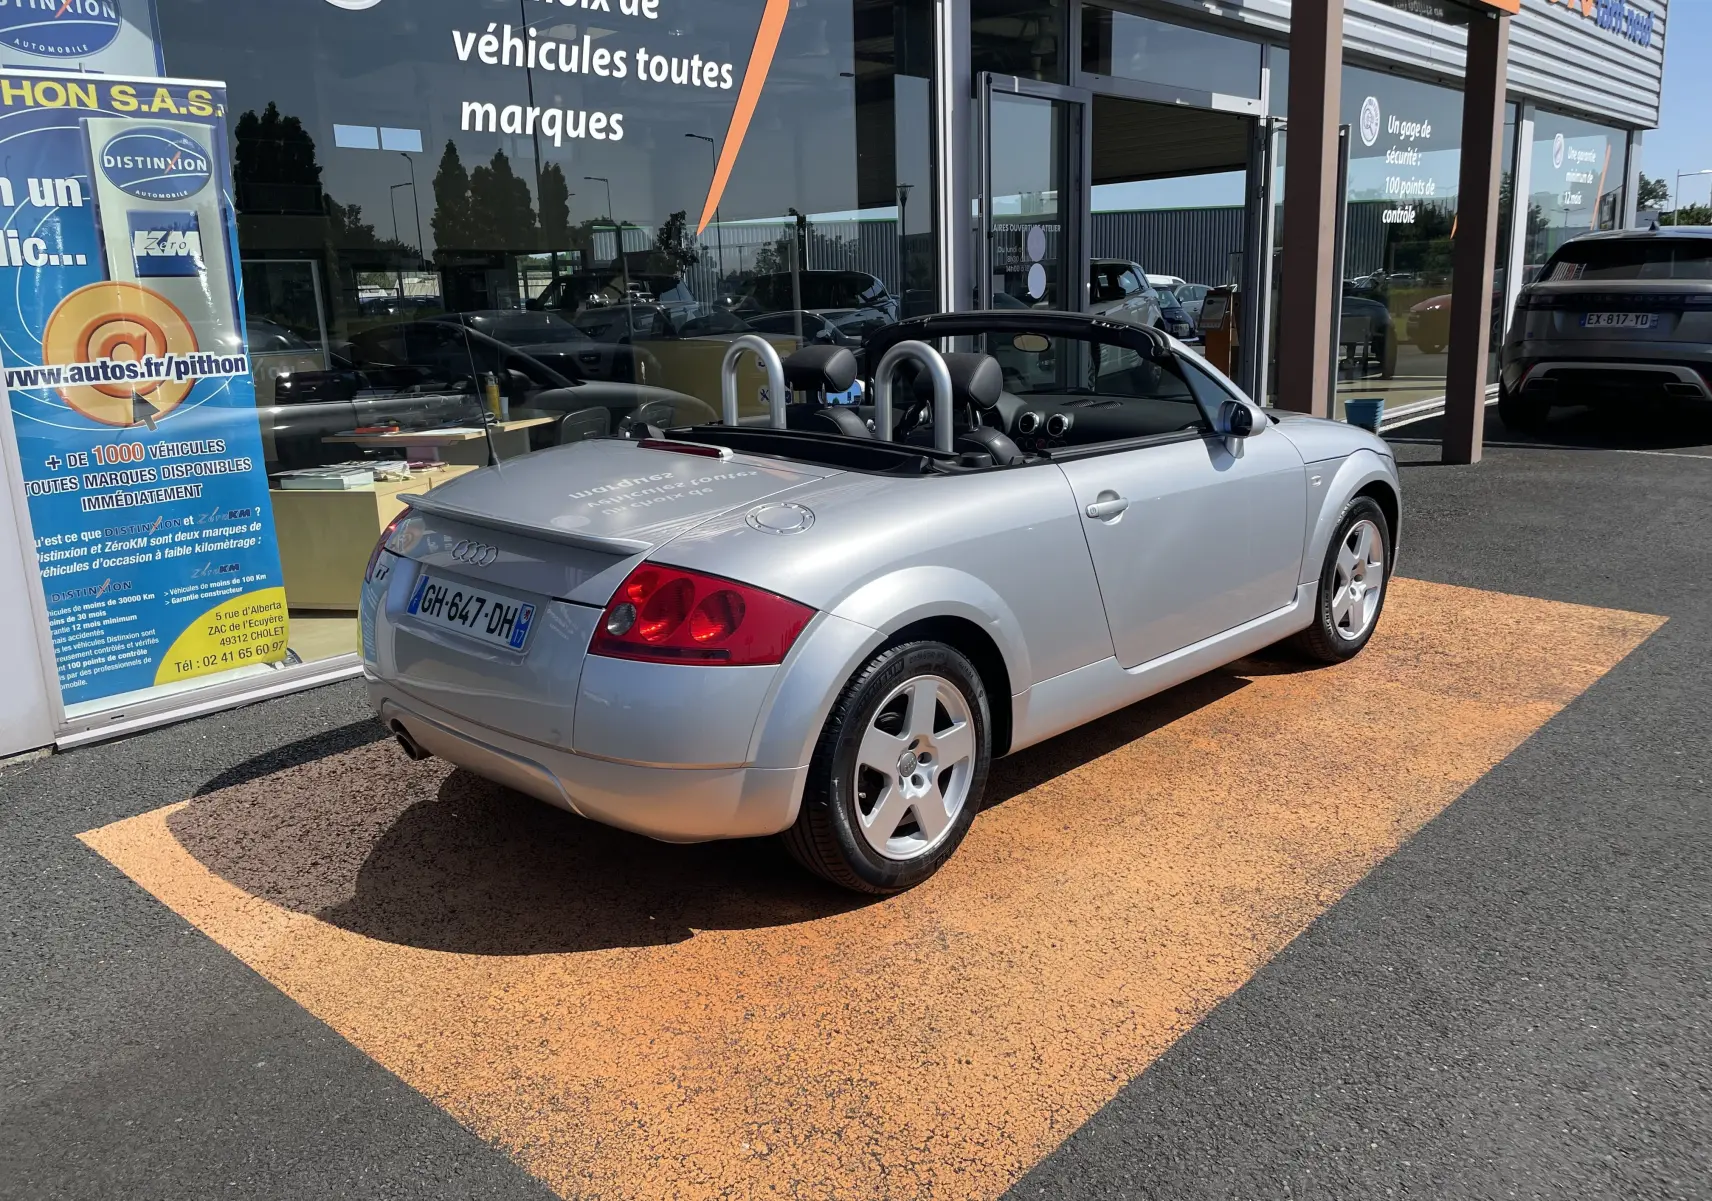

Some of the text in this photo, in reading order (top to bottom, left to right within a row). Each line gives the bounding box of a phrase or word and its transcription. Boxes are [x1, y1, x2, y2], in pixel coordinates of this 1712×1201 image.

[14, 38, 88, 54] AUTOMOBILE
[452, 22, 733, 89] véhicules toutes
[110, 85, 223, 117] S.A.S.
[461, 100, 624, 147] marques
[1388, 115, 1431, 141] Un gage de
[104, 153, 207, 172] DISTINXION
[27, 178, 83, 207] un
[135, 190, 189, 199] AUTOMOBILE
[1385, 176, 1435, 198] 100 points de
[1382, 205, 1415, 224] contrôle
[1587, 314, 1649, 325] EX-817-YD
[67, 453, 88, 468] DE
[92, 443, 144, 465] 1000
[148, 440, 226, 460] VÉHICULES
[84, 468, 157, 489] MARQUES
[162, 458, 253, 480] DISPONIBLES
[81, 483, 203, 512] IMMÉDIATEMENT
[65, 534, 78, 543] ce
[81, 530, 102, 542] que
[104, 517, 181, 537] DISTINXION
[183, 516, 194, 525] et
[255, 506, 260, 516] ?
[91, 544, 102, 554] et
[105, 537, 147, 553] ZéroKM
[150, 536, 172, 546] sont
[175, 531, 199, 542] deux
[202, 525, 247, 539] marques
[250, 521, 261, 531] de
[92, 553, 152, 569] d'occasion
[155, 550, 161, 560] à
[164, 547, 192, 559] faible
[195, 537, 256, 553] kilomètrage
[51, 580, 132, 602] DISTINXION
[169, 584, 199, 595] Véhicules
[210, 580, 230, 588] moins
[242, 575, 254, 583] 100
[256, 573, 267, 581] Km
[83, 601, 105, 610] moins
[118, 595, 141, 604] 30000
[171, 586, 243, 604] Garantie constructeur
[88, 610, 107, 618] mois
[215, 602, 281, 620] 5 rue d'Alberta
[421, 584, 518, 639] GH-647-DH
[71, 623, 81, 631] 12
[83, 620, 101, 629] mois
[103, 614, 137, 625] minimum
[208, 615, 284, 636] ZAC de l'Ecuyère
[68, 629, 104, 641] accidentés
[73, 638, 105, 650] véhicules
[107, 633, 139, 643] Distinxion
[141, 629, 155, 637] sont
[94, 642, 125, 654] contrôlés
[135, 637, 159, 647] vérifiés
[219, 626, 285, 646] 49312 CHOLET
[67, 662, 81, 670] 100
[83, 657, 105, 667] points
[118, 649, 148, 659] contrôle
[174, 660, 192, 673] Tél
[203, 655, 217, 667] 02
[221, 651, 234, 662] 41
[238, 647, 252, 659] 65
[256, 643, 270, 655] 60
[272, 641, 284, 652] 97
[67, 671, 78, 680] par
[80, 669, 92, 677] des
[93, 659, 141, 675] professionnels
